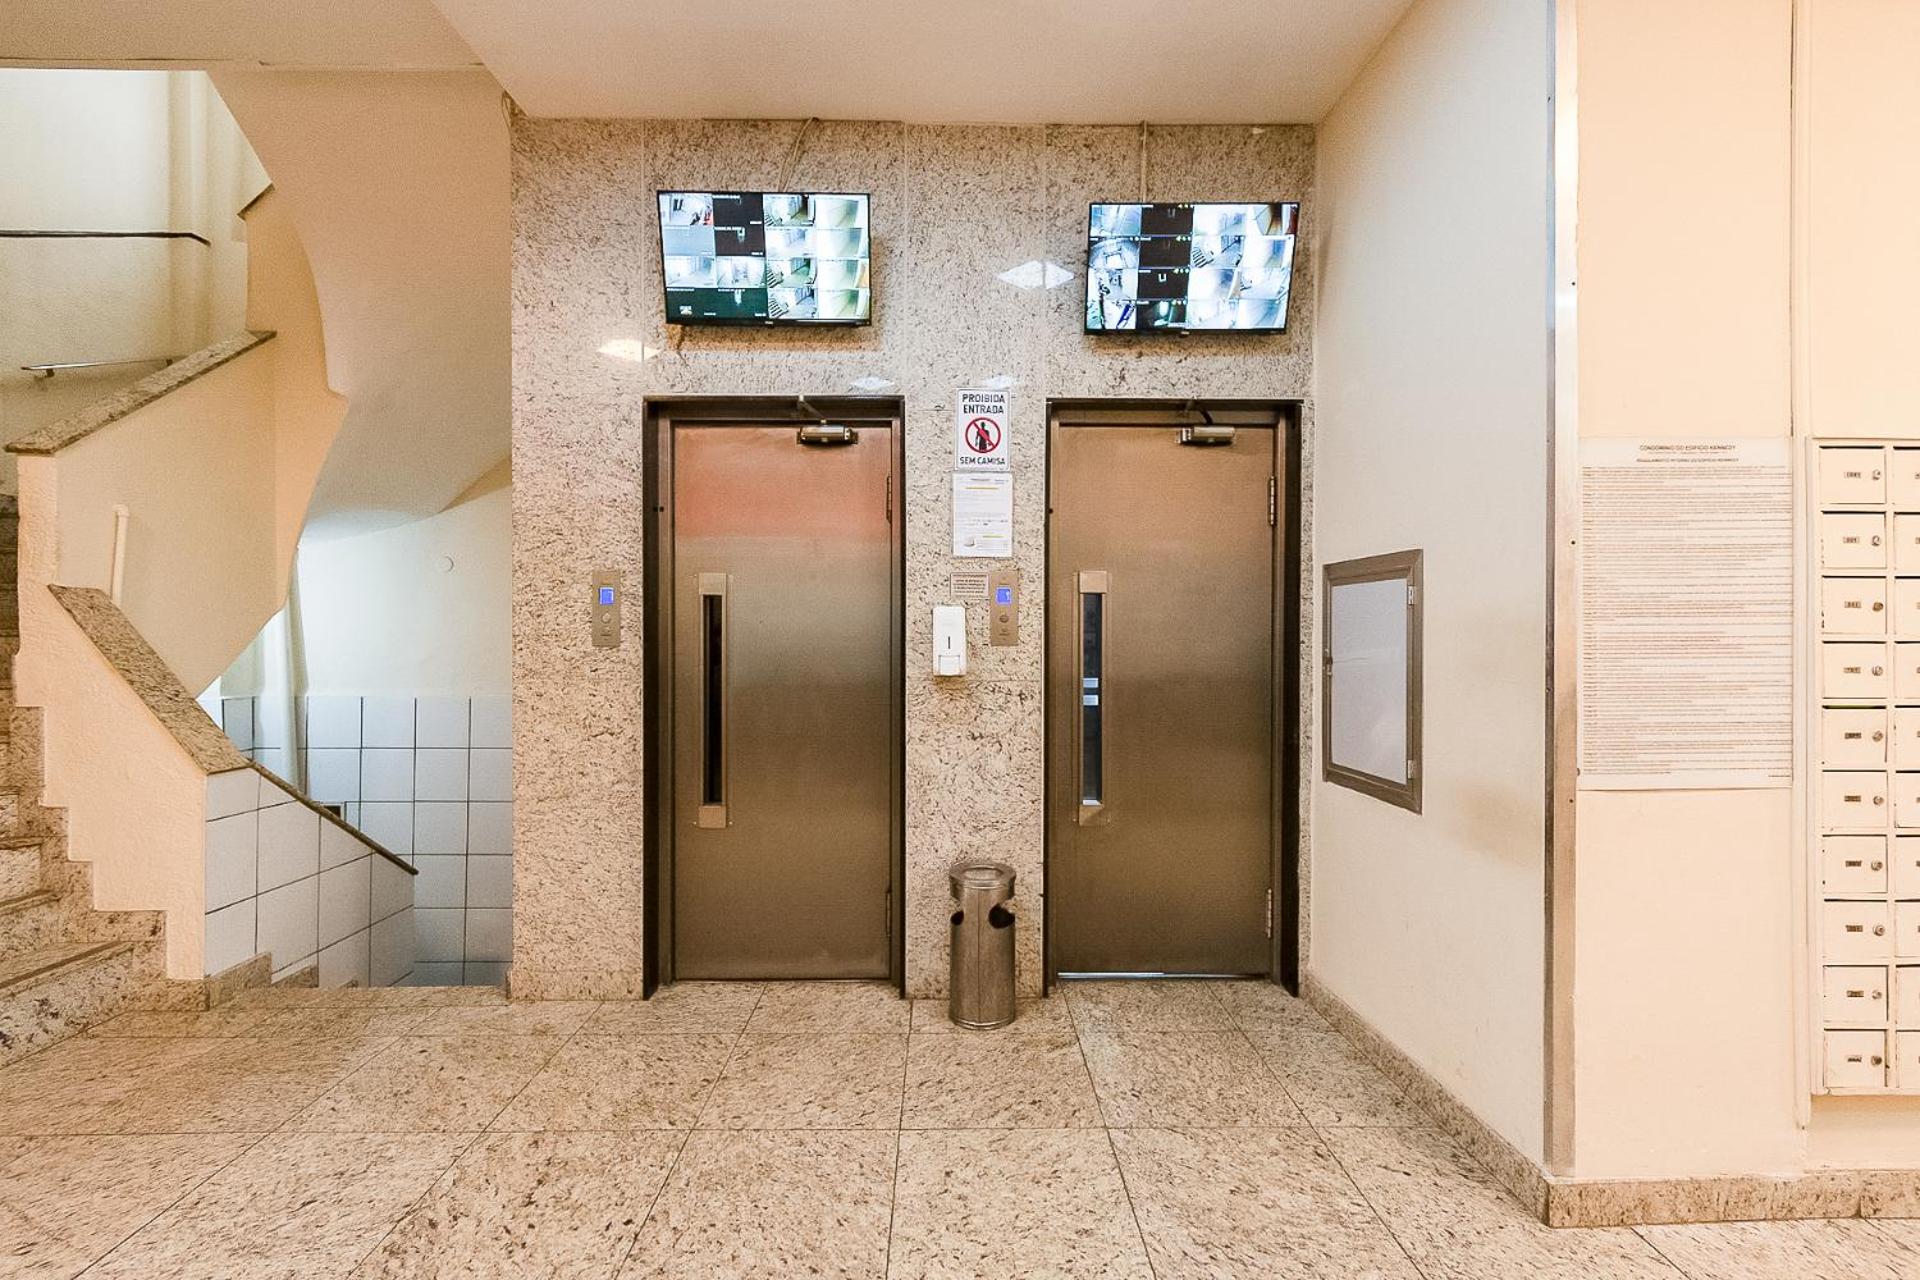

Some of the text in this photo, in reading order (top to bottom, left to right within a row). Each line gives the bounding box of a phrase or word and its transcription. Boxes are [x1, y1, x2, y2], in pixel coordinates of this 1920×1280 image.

[962, 393, 1006, 403] PROIBIDA
[963, 404, 1004, 414] ENTRADA
[959, 456, 1006, 465] SEM CAMISA
